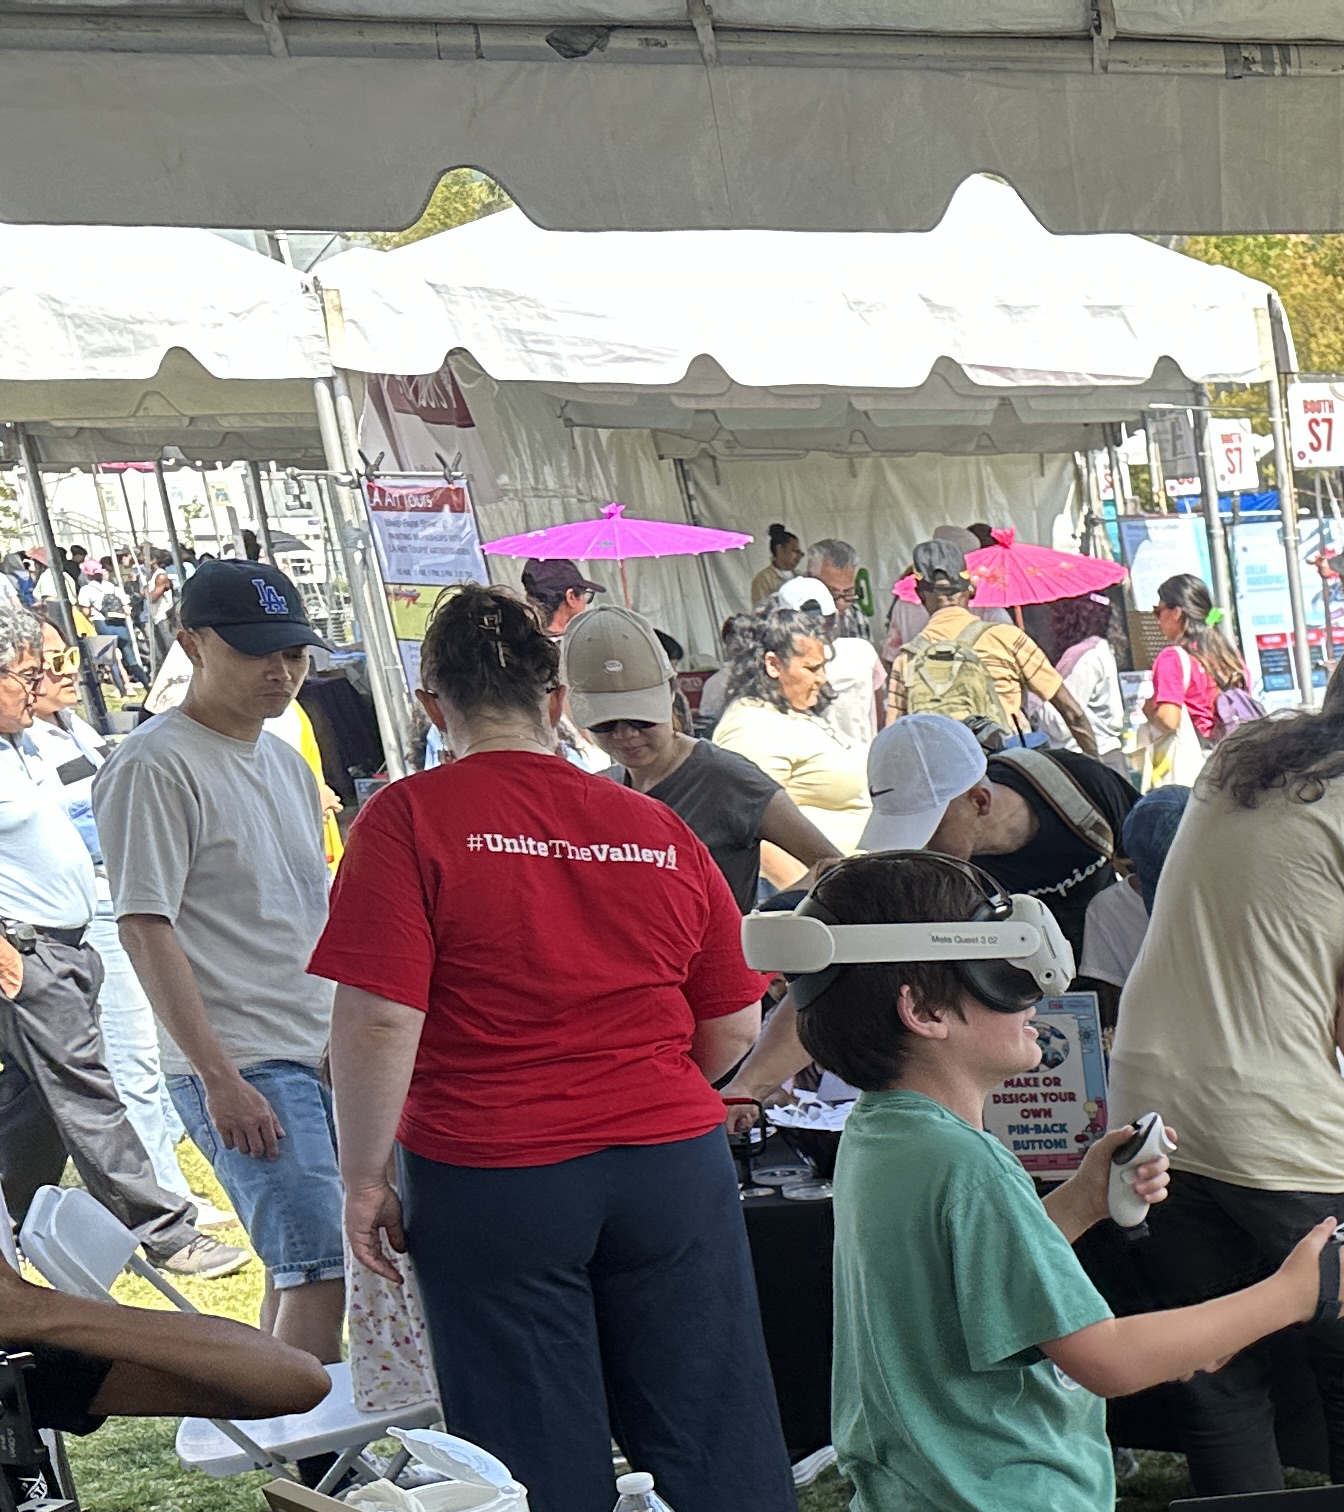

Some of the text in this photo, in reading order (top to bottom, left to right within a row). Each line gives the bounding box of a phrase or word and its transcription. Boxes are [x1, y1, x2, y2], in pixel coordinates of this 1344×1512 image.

[1303, 399, 1334, 414] BOOTH
[1307, 417, 1334, 452] S7
[1225, 447, 1243, 474] S7
[251, 578, 289, 615] LA
[931, 935, 953, 944] Meta
[954, 935, 979, 944] Quest
[980, 936, 987, 944] 3
[1004, 1076, 1062, 1088] MAKE OR
[992, 1091, 1077, 1105] DESIGN YOUR
[1020, 1108, 1053, 1119] OWN
[1008, 1123, 1069, 1135] PIN-BACK
[1013, 1137, 1067, 1151] BUTTON!
